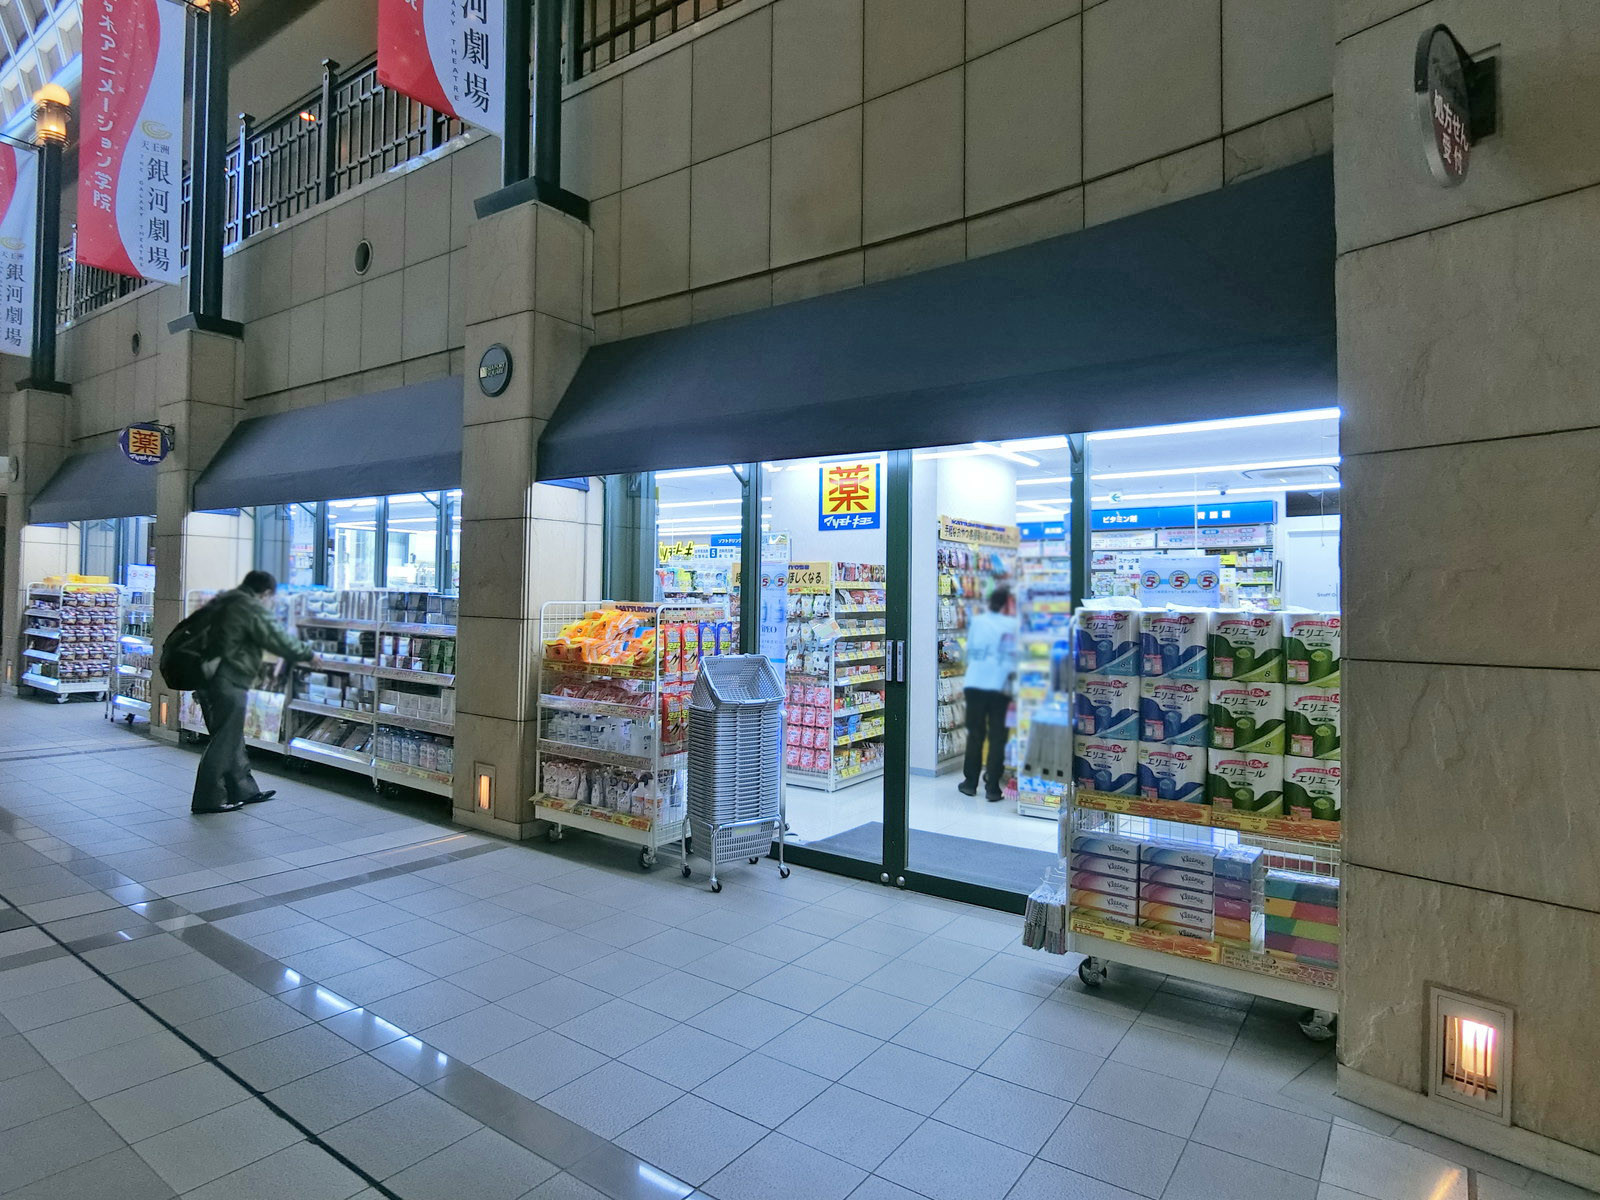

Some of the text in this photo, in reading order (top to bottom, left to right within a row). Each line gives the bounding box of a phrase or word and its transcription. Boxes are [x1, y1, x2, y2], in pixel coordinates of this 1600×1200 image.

[451, 39, 460, 101] THEATRE
[1434, 89, 1468, 151] 処方せん
[142, 140, 170, 155] 天王洲
[1443, 132, 1463, 175] 受付
[147, 157, 173, 272] 銀河劇場
[5, 263, 25, 347] 銀河劇場
[132, 430, 158, 454] 薬
[829, 464, 870, 512] 薬
[824, 515, 874, 529] マツモトキヨシ
[711, 549, 717, 557] 5
[777, 578, 785, 587] 5
[1085, 622, 1123, 630] エリエール
[1149, 625, 1190, 634] エリエール
[1221, 627, 1268, 637] エリエール
[1084, 688, 1122, 697] エリエール
[1152, 691, 1194, 702] エリエール
[1221, 697, 1268, 707] エリエール
[1083, 751, 1122, 762] エリエール
[1146, 758, 1187, 769] エリエール
[1220, 767, 1266, 778] エリエール
[1108, 845, 1130, 856] Kleenex
[1181, 856, 1205, 867] Kleenex
[1107, 862, 1130, 873] Kleenex
[1107, 880, 1130, 891] Kleenex
[1181, 874, 1206, 886] Kleenex
[1106, 898, 1129, 910] Kleenex
[1180, 893, 1205, 904] Kleenex
[1180, 912, 1205, 923] Kleenex
